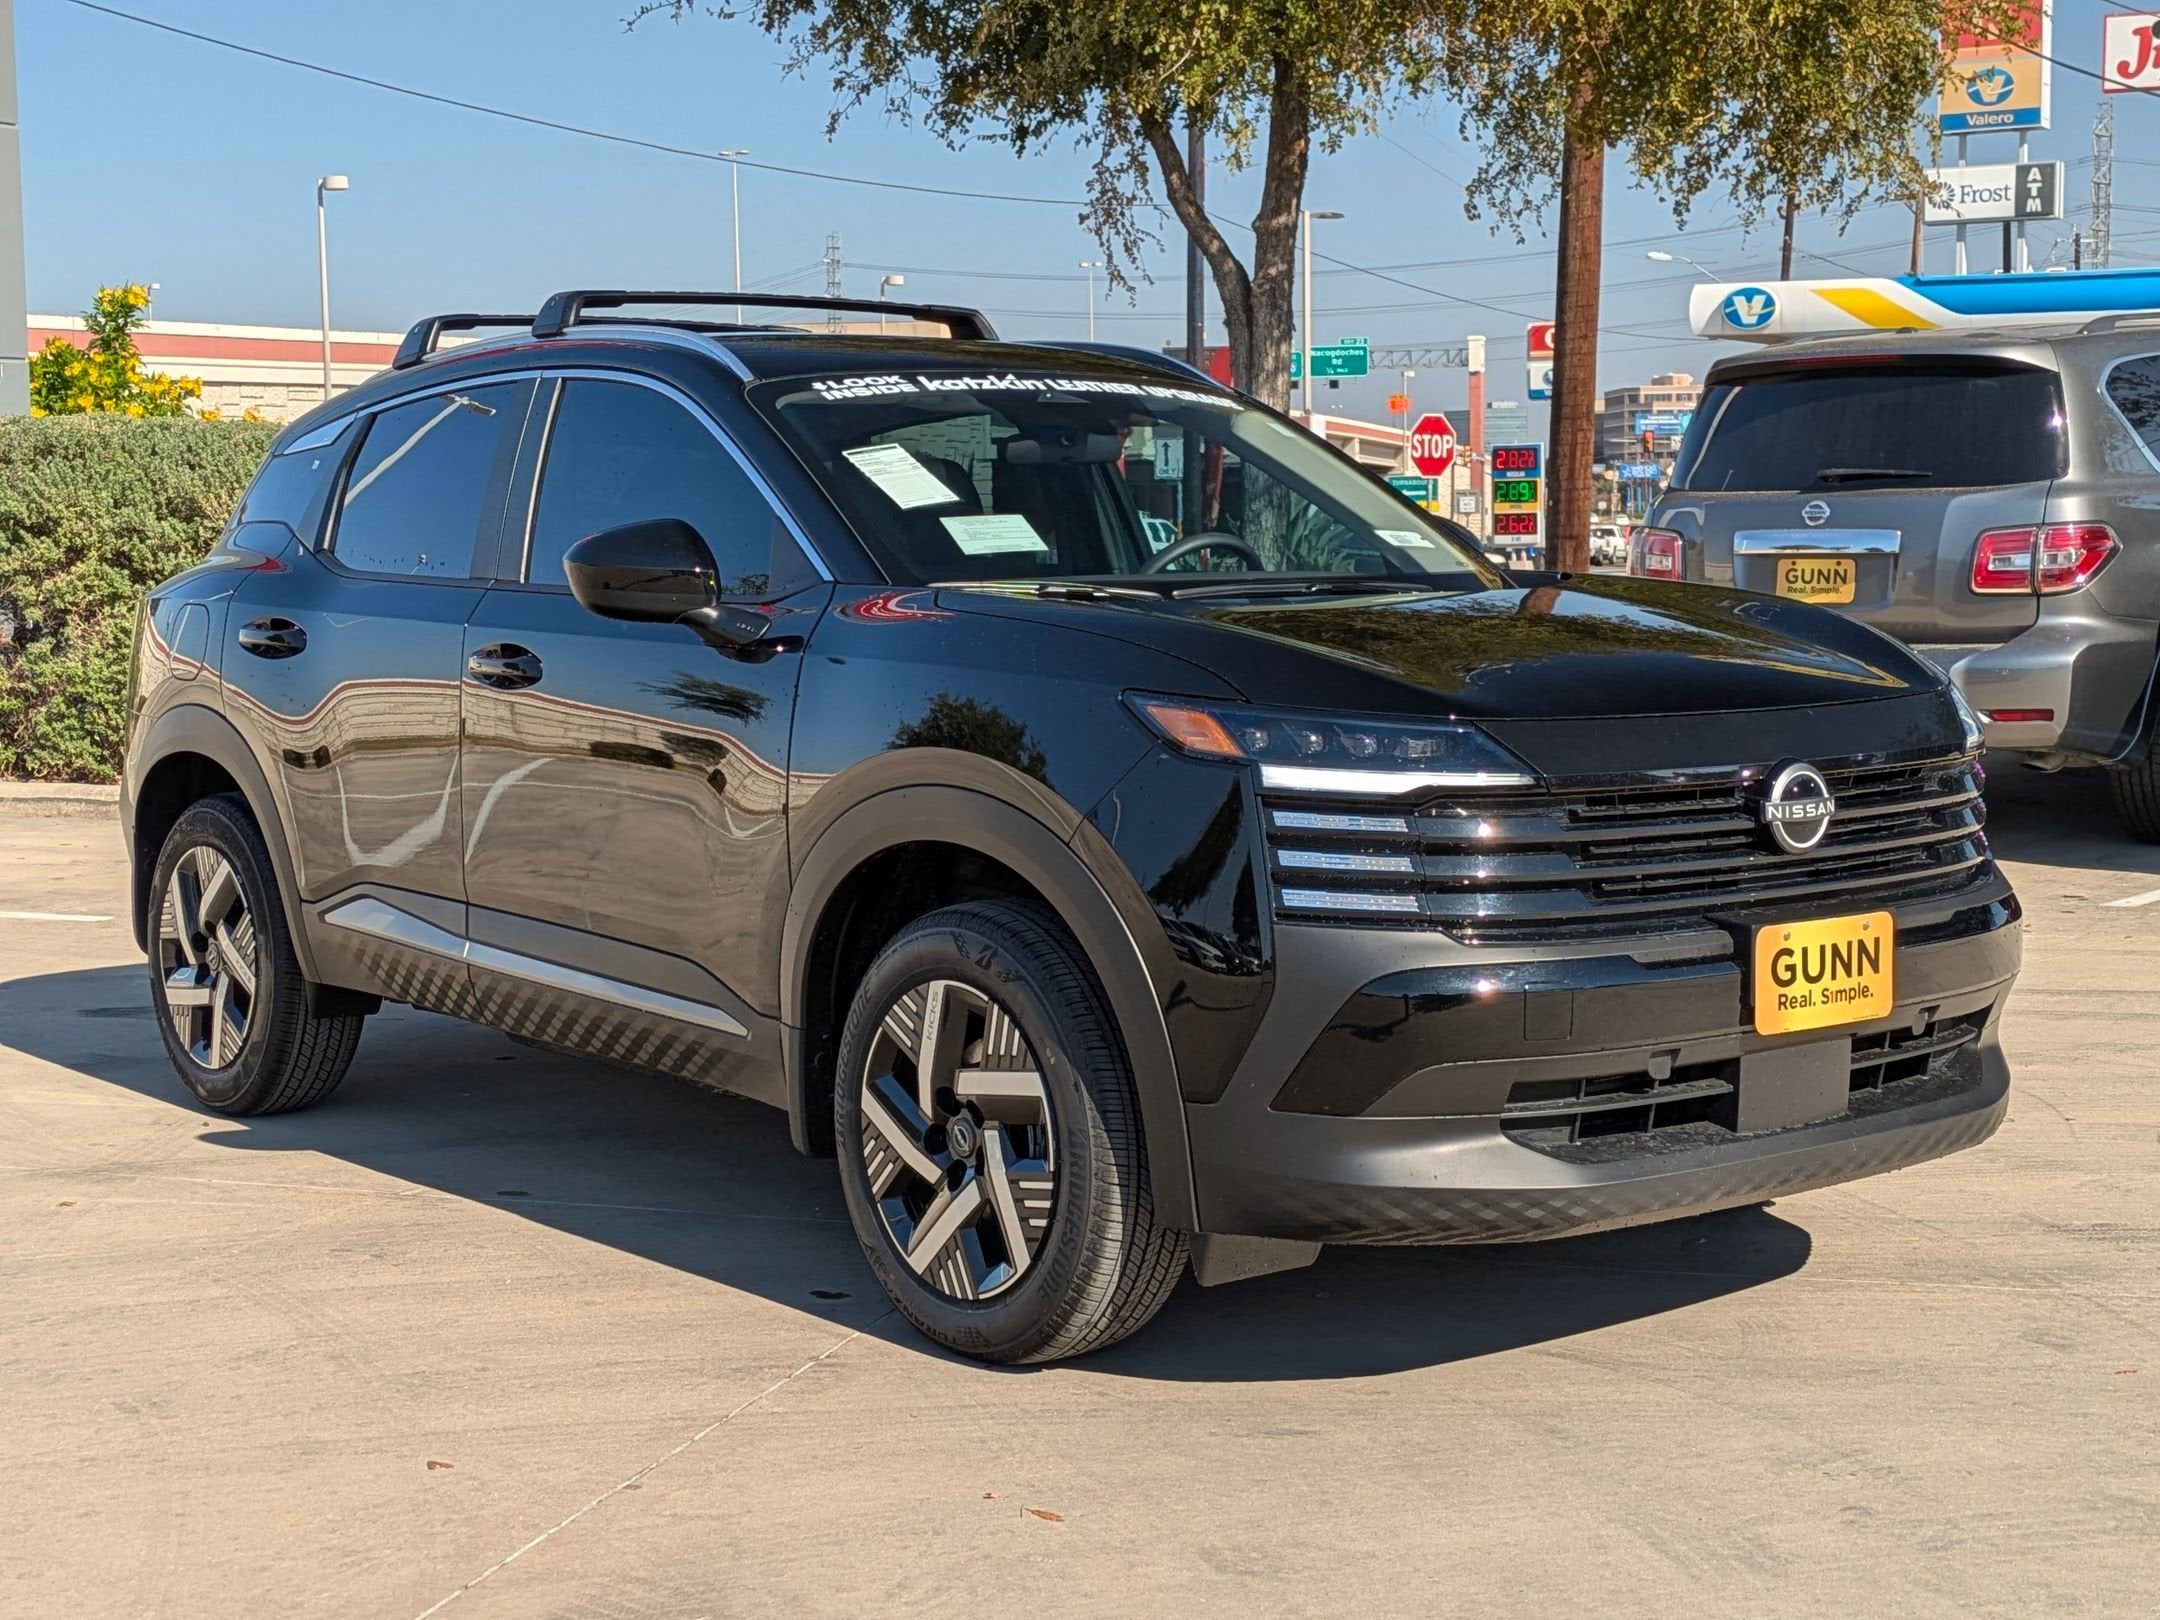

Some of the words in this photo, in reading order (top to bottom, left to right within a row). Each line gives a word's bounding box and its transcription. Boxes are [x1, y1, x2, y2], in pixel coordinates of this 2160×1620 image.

[1967, 113, 2014, 126] Valero
[1959, 184, 2012, 203] Frost
[2025, 167, 2042, 213] ATM
[1311, 349, 1365, 358] Nacogdoches
[1331, 358, 1343, 366] Rd
[820, 384, 920, 400] INSIDE
[916, 374, 1046, 391] katzkin
[1043, 379, 1149, 395] LEATHER
[826, 375, 909, 389] LOOK
[1412, 434, 1453, 458] STOP
[1785, 568, 1848, 585] GUNN
[1767, 796, 1835, 820] NISSAN
[1771, 936, 1880, 988] GUNN
[1777, 992, 1816, 1011] Real.
[926, 990, 939, 1041] KICKS
